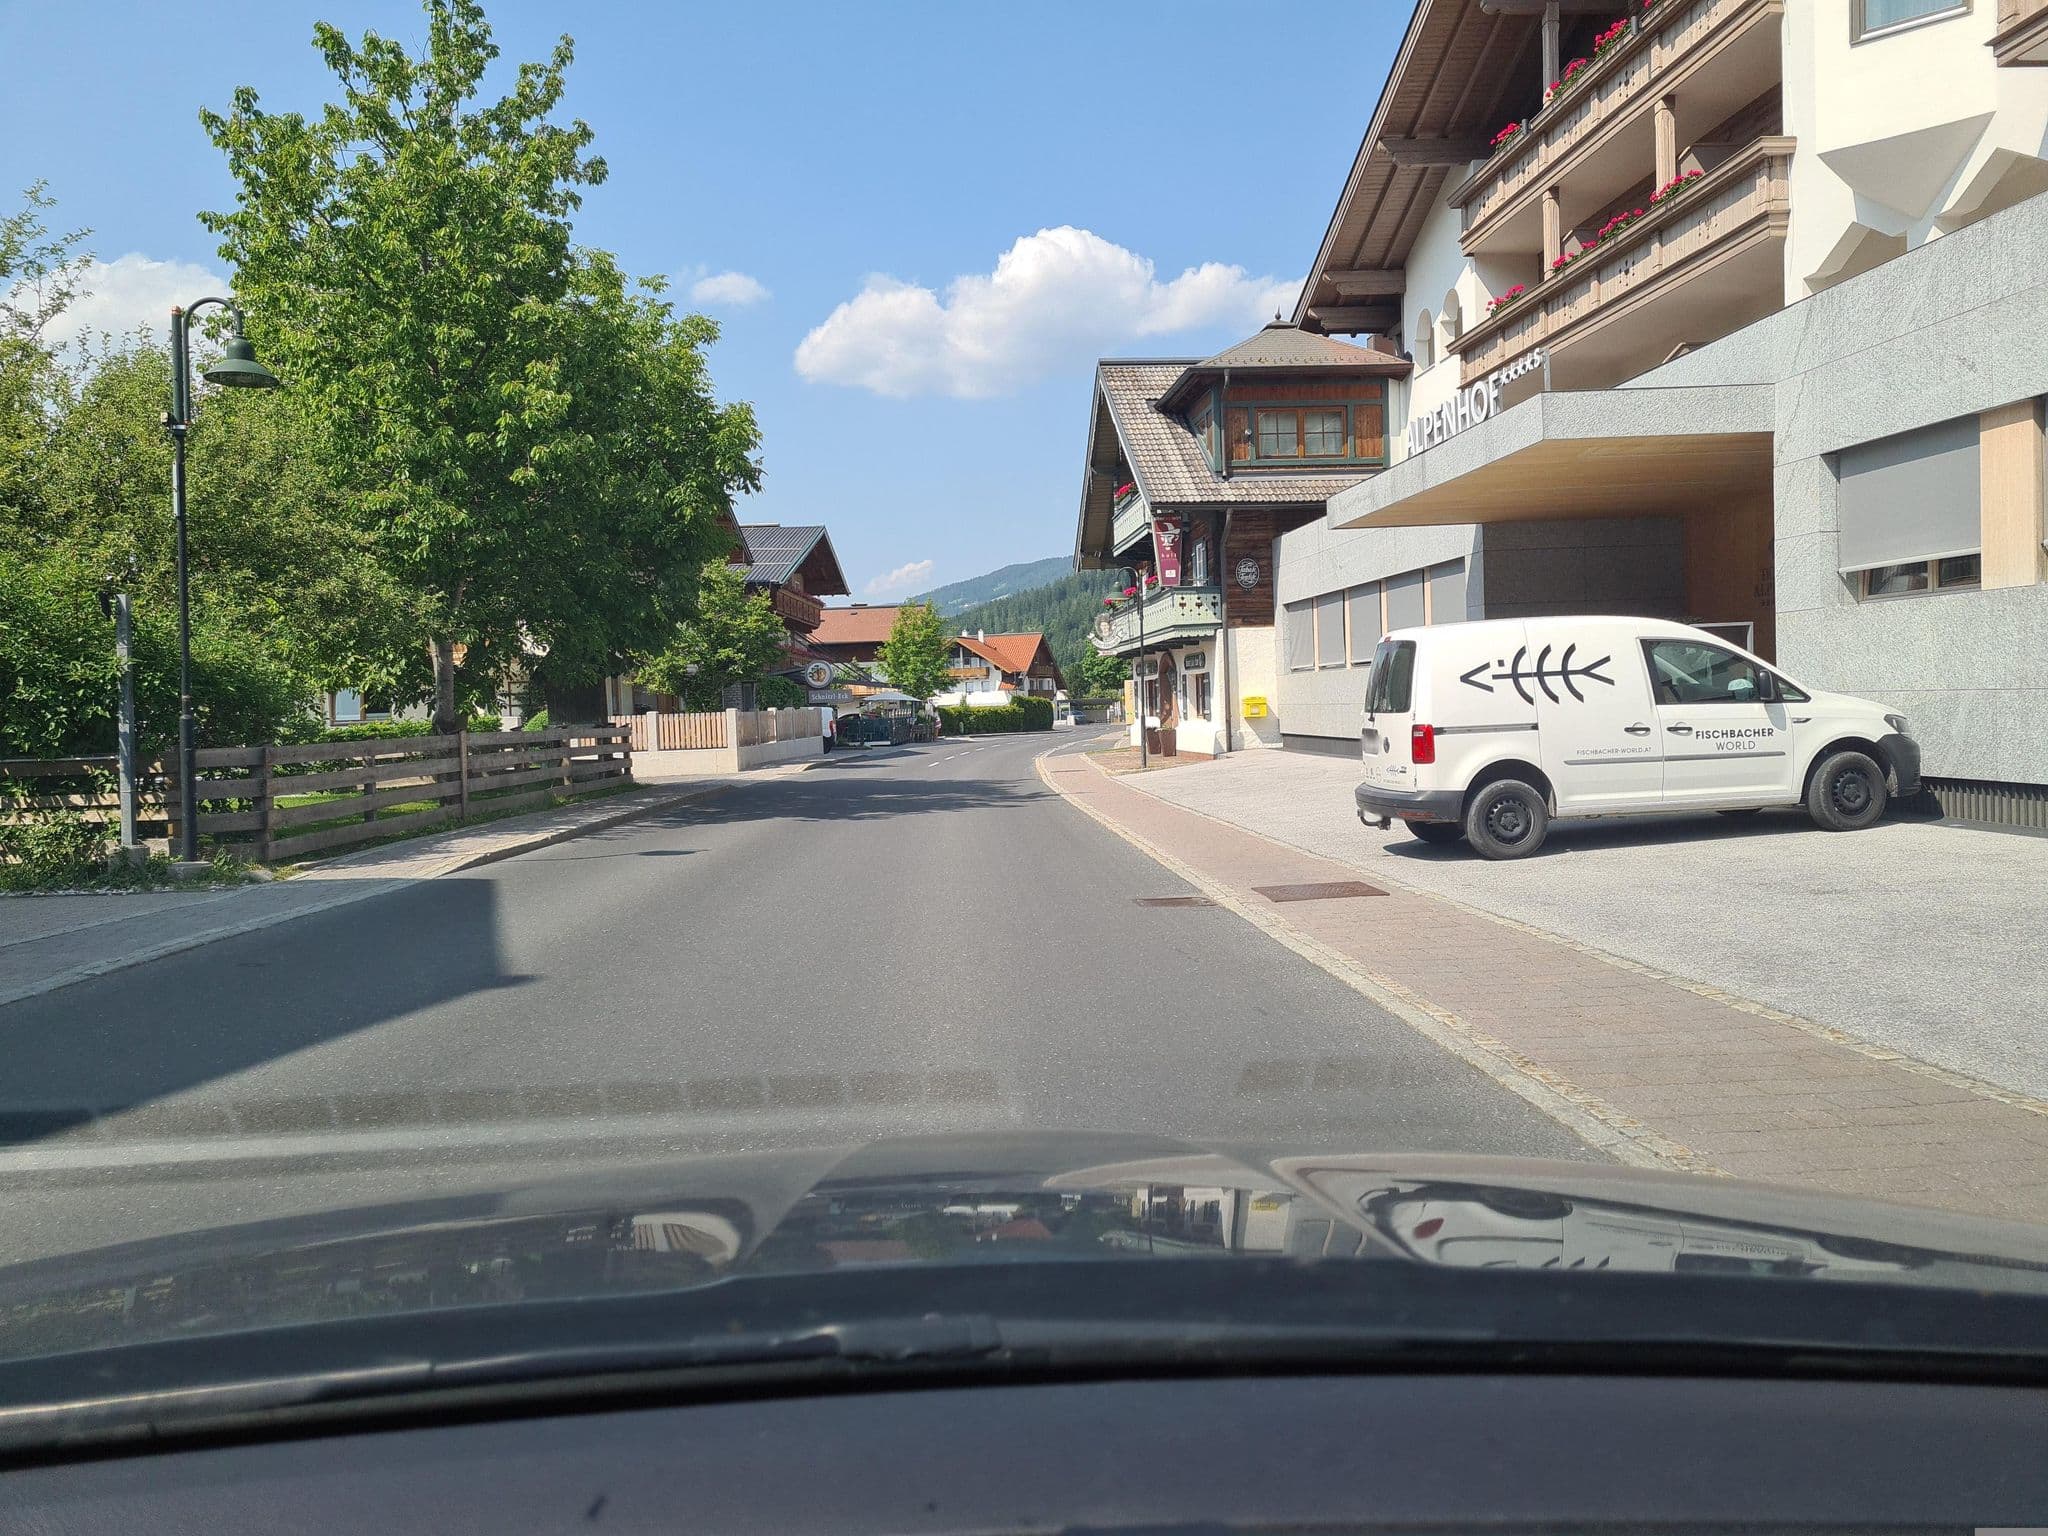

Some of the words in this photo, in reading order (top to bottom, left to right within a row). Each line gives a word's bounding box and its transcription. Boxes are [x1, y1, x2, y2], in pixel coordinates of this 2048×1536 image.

[1407, 371, 1501, 457] ALPENHOF
[1695, 728, 1774, 740] FISCHBACHER
[1716, 740, 1756, 751] WORLD
